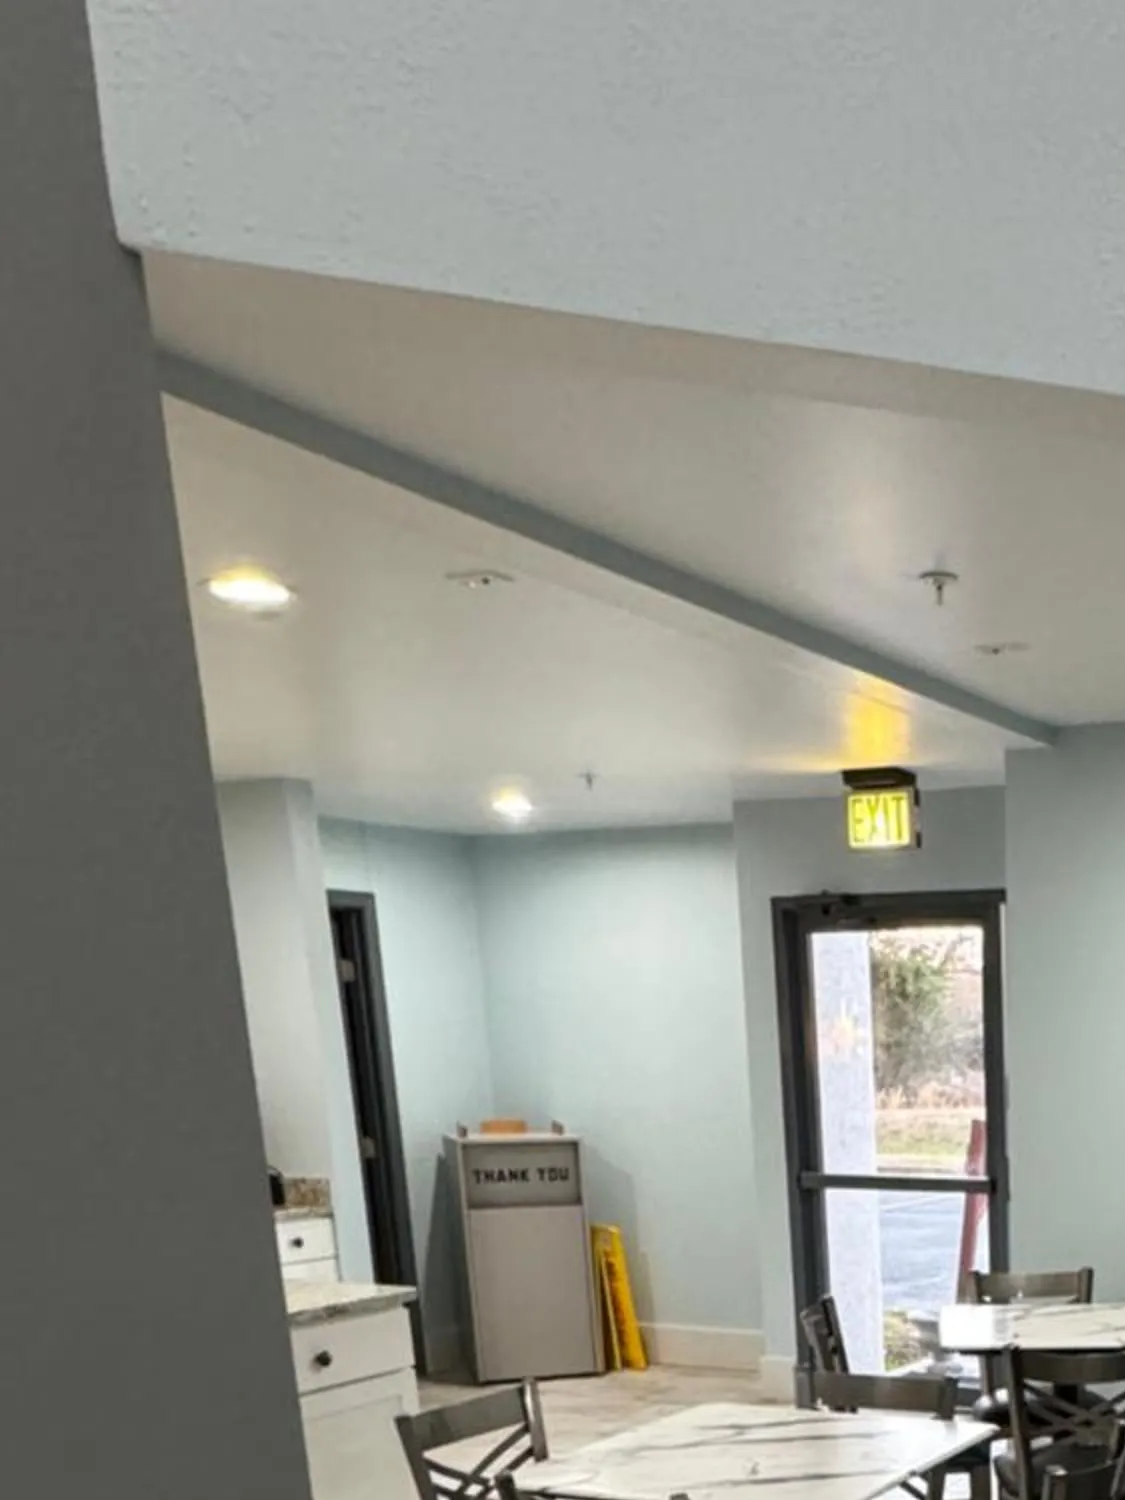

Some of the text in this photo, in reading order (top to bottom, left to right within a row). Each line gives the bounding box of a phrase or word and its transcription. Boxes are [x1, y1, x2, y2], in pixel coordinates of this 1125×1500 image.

[851, 795, 904, 843] EXIT
[473, 1167, 570, 1184] THANK YOU
